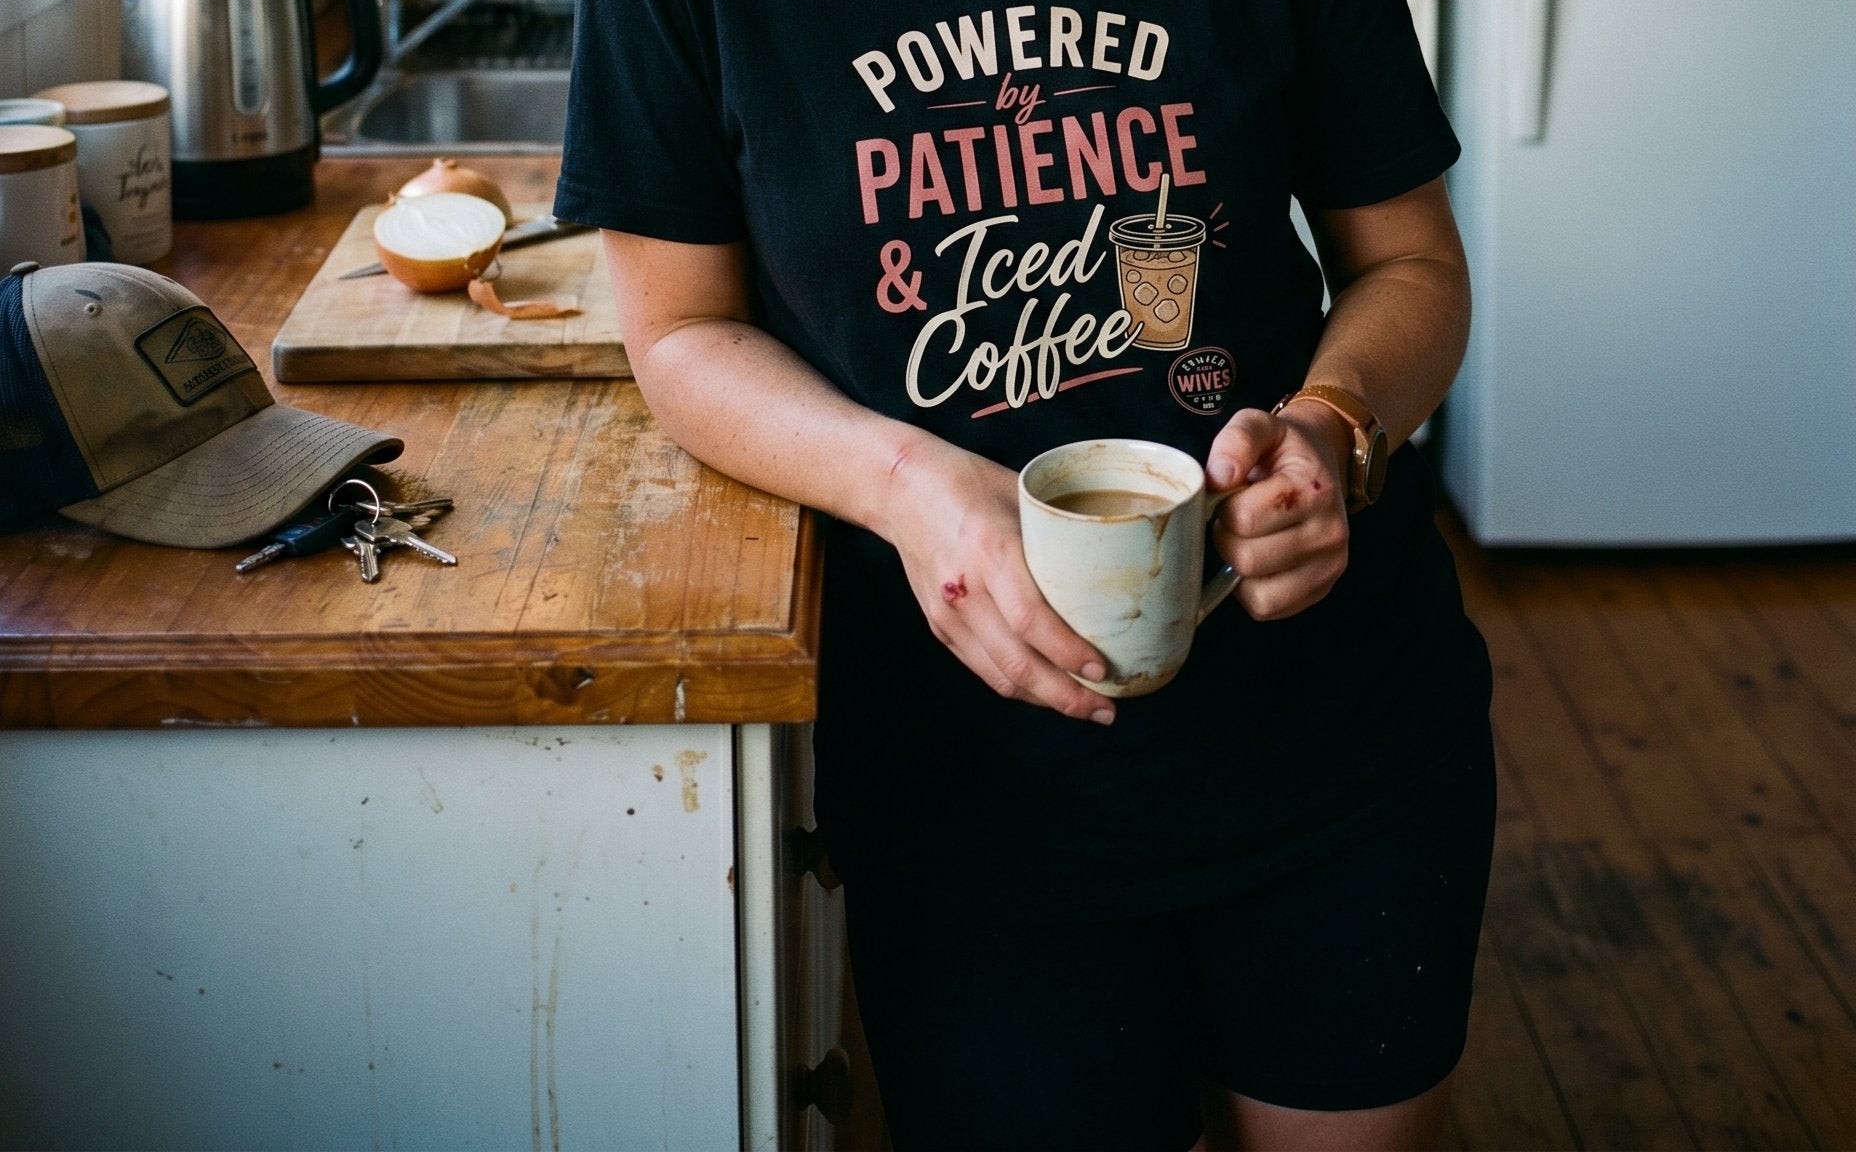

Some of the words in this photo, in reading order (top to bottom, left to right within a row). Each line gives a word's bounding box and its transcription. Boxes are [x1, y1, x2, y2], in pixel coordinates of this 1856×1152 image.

[852, 5, 1170, 114] POWERED
[995, 72, 1047, 125] by
[855, 102, 1207, 225] PATIENCE
[876, 239, 928, 314] &
[935, 204, 1107, 318] Iced
[905, 292, 1144, 409] Coffee
[1176, 368, 1231, 393] WIVES
